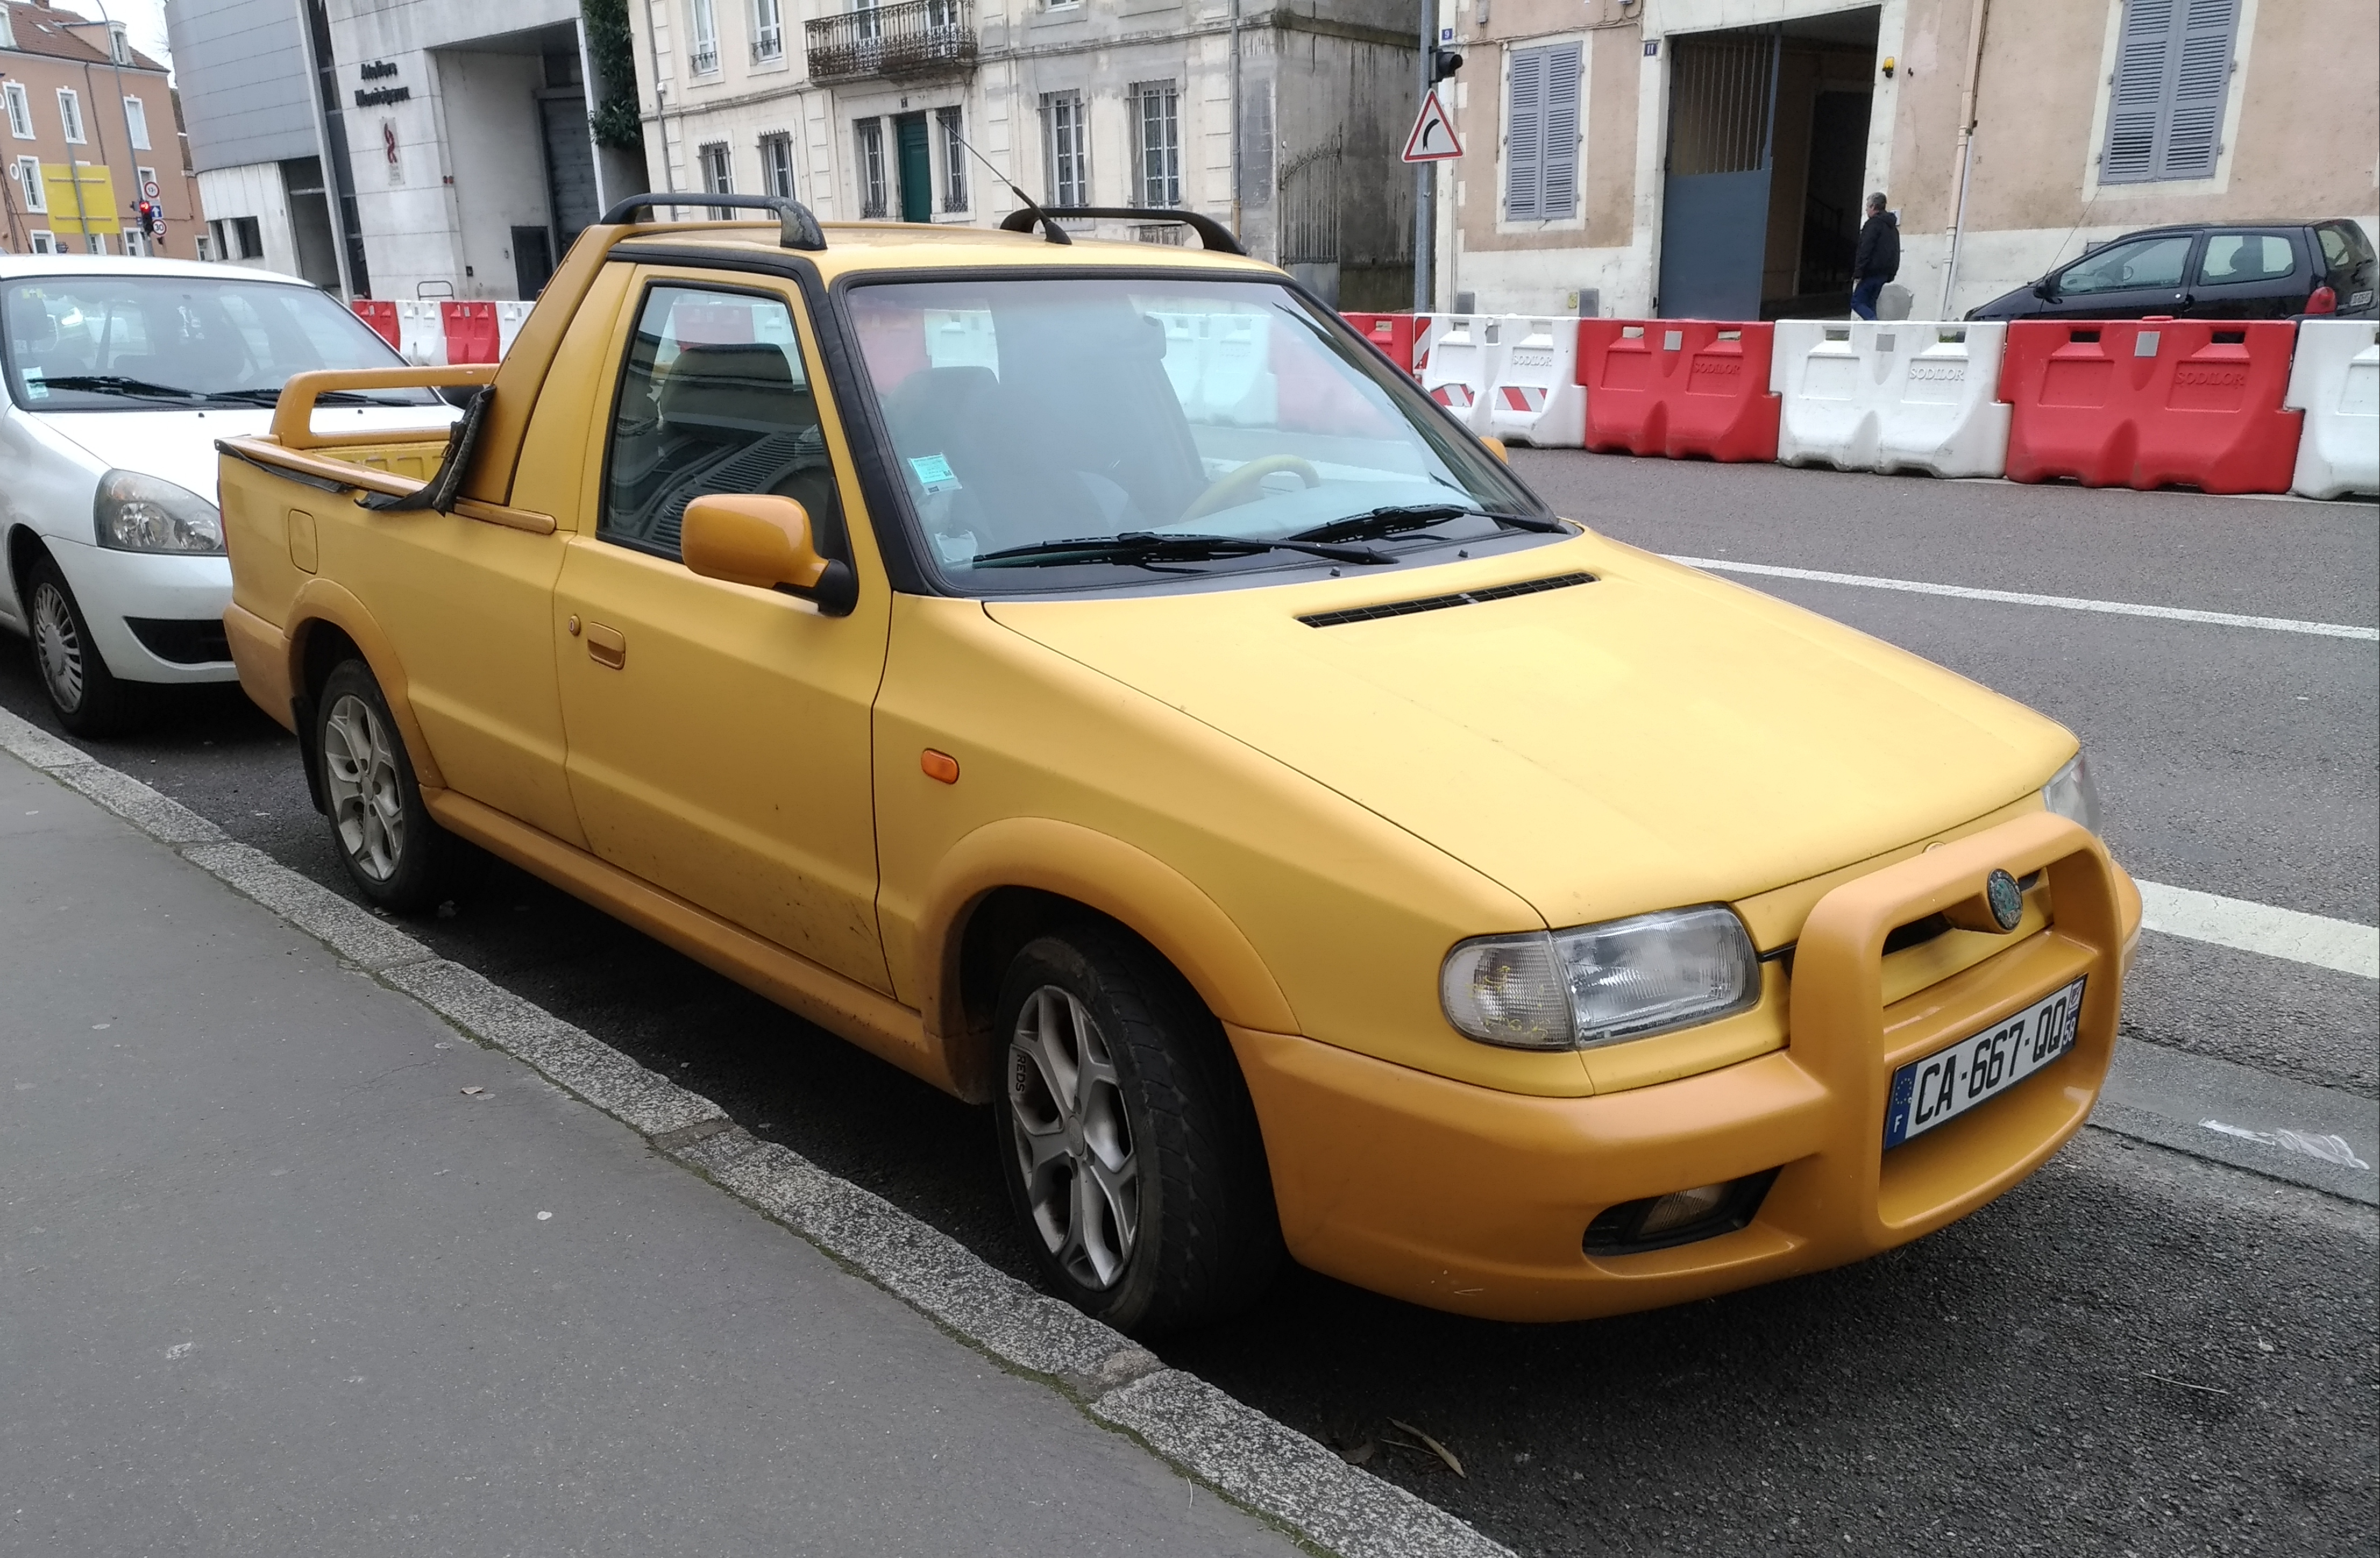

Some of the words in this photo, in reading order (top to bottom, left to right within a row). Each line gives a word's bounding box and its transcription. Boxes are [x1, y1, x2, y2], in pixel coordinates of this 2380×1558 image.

[1444, 30, 1450, 39] 9
[1646, 44, 1654, 55] 11
[360, 60, 398, 81] Ateliers
[354, 86, 411, 108] Municipaux
[154, 223, 164, 231] 30
[1513, 355, 1552, 367] SODILOR
[1909, 367, 1964, 381] SODILOR
[2175, 372, 2244, 386] SODILOR
[1893, 1114, 1903, 1134] F
[1915, 995, 2068, 1126] CA-667-QQ
[2063, 1016, 2077, 1046] 58
[1015, 1054, 1026, 1092] REDS
